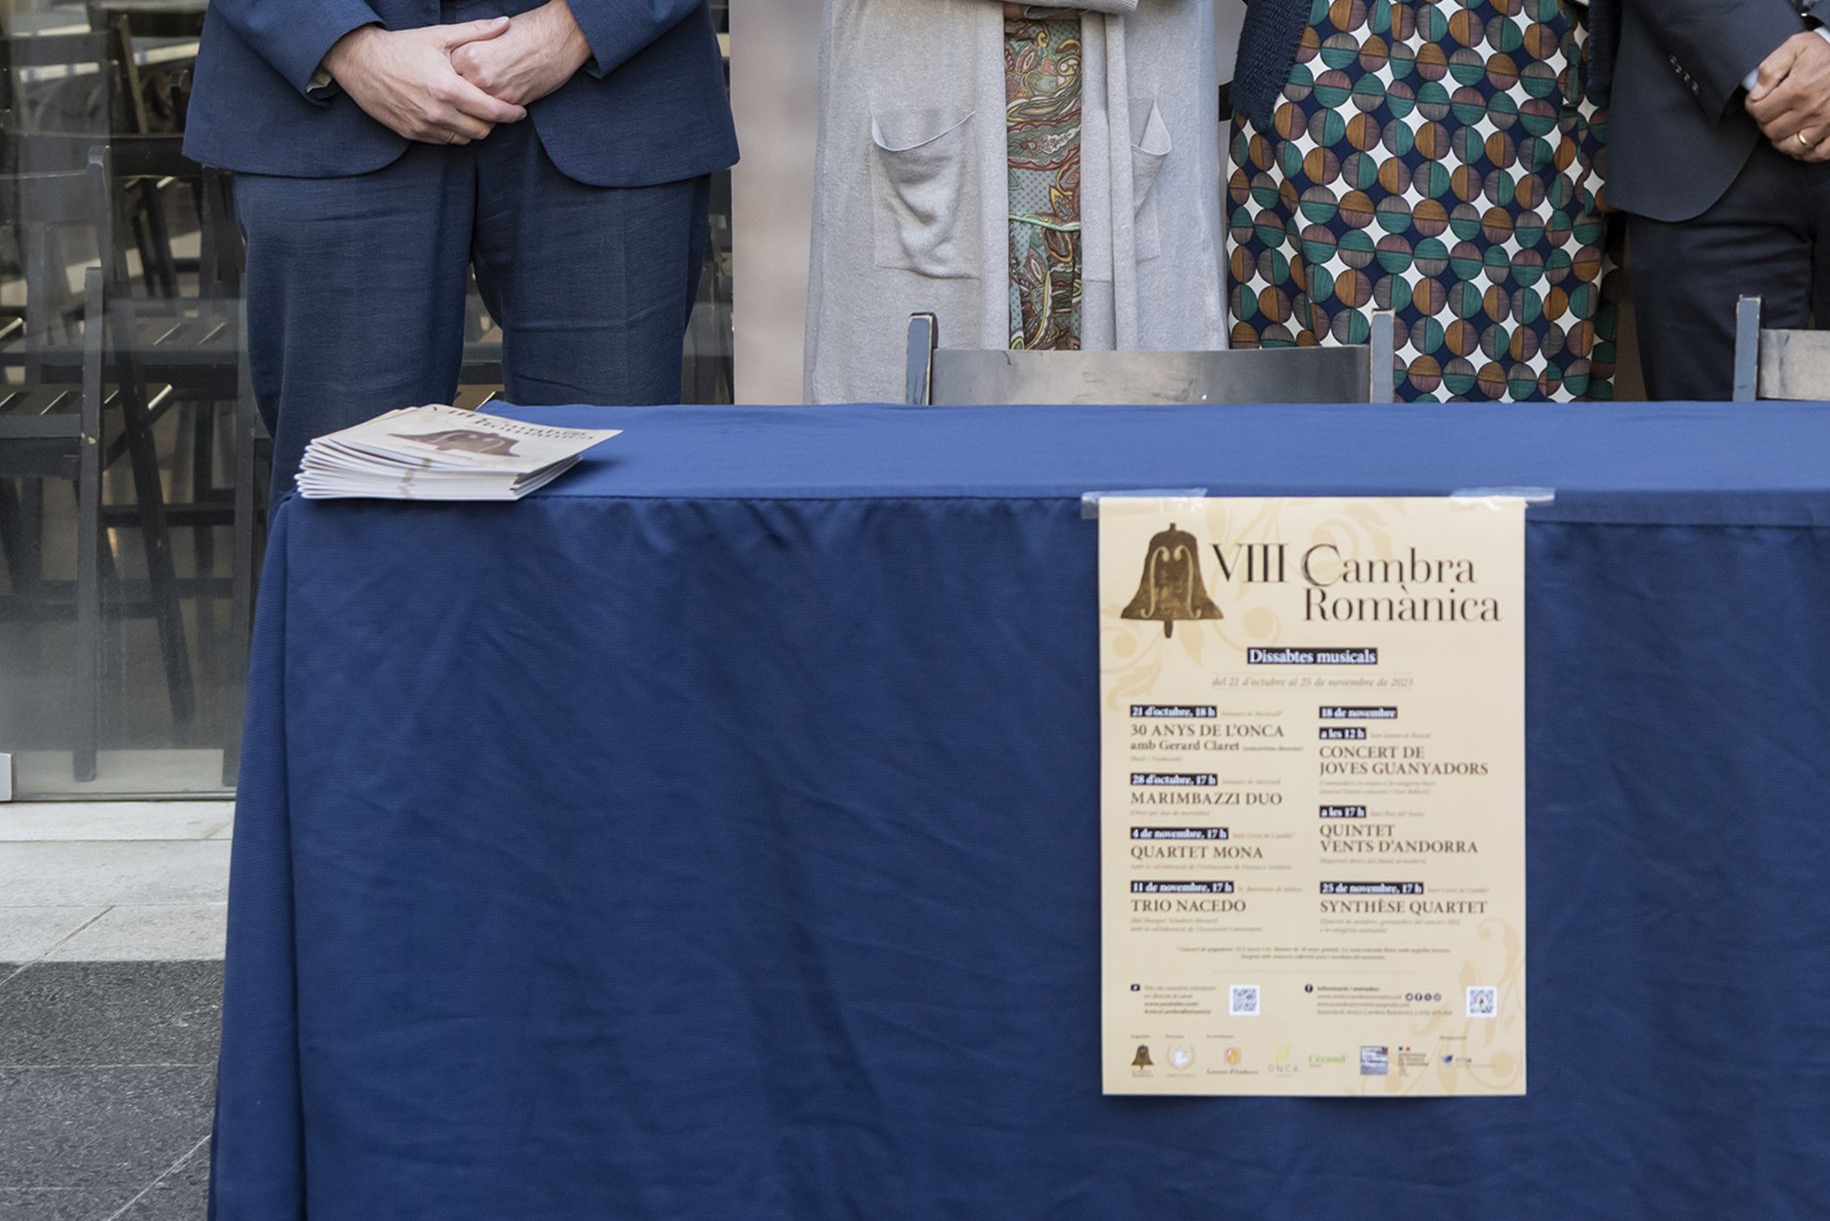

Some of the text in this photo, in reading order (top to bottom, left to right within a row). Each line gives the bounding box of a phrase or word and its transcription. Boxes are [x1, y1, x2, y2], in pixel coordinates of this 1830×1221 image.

[1209, 543, 1476, 588] VIII Cambra
[1303, 582, 1501, 621] Romànica
[1249, 649, 1376, 664] Dissabtes musicals
[1131, 724, 1284, 737] 30 ANYS DE L'ONCA
[1131, 740, 1156, 751] amb
[1159, 740, 1200, 751] Gerard
[1204, 740, 1239, 751] Claret
[1319, 746, 1398, 759] CONCERT
[1403, 746, 1424, 759] DE
[1320, 762, 1488, 776] JOVES GUANYADORS
[1131, 792, 1282, 805] MARIMBAZZI DUO
[1320, 824, 1395, 838] QUINTET
[1131, 846, 1263, 859] QUARTET MONA
[1321, 840, 1478, 853] VENTS D'ANDORRA
[1131, 899, 1246, 912] TRIO NACEDO
[1320, 899, 1487, 915] SYNTHÈSE QUARTET
